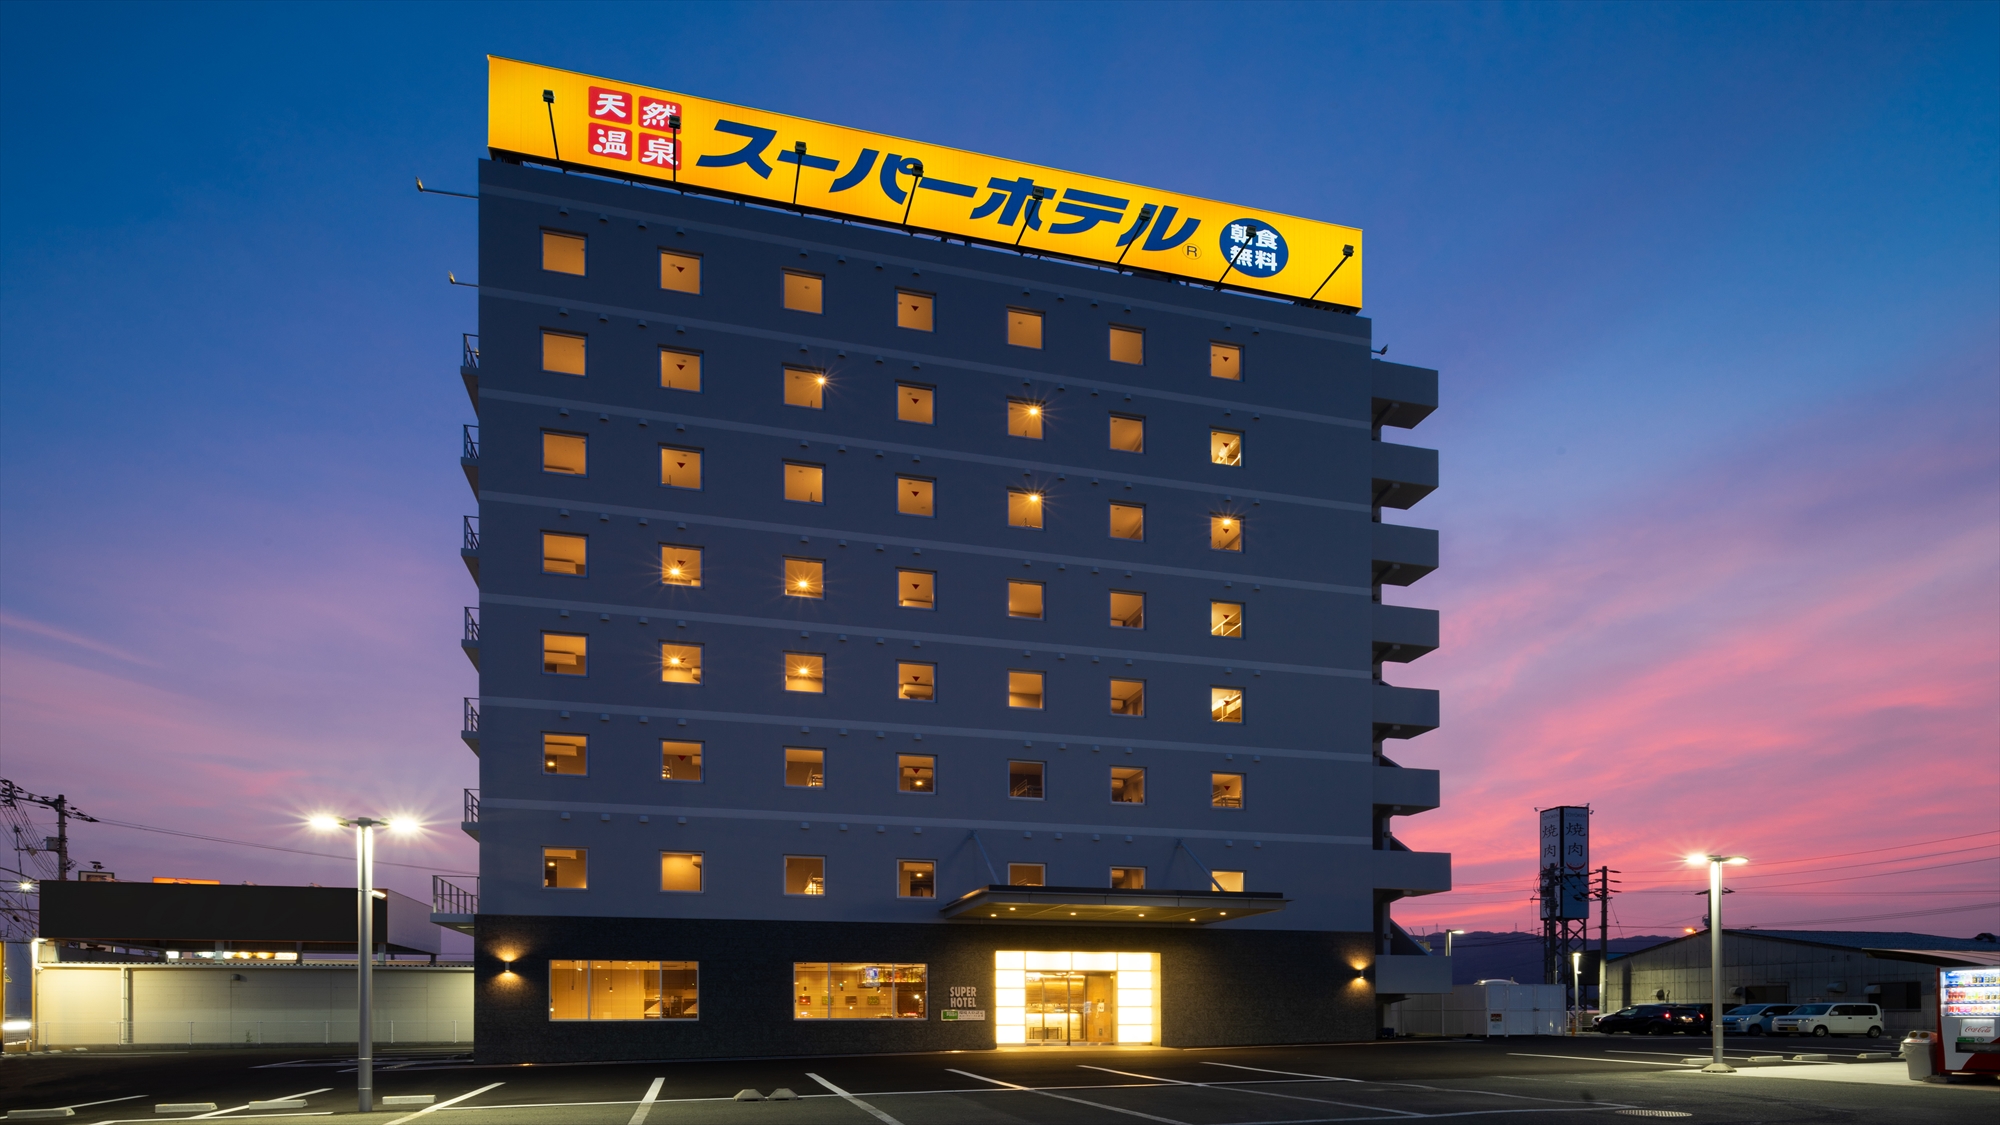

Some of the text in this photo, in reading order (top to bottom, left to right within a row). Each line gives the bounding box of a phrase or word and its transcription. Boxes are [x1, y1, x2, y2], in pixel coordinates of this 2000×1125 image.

[595, 93, 677, 127] 天然
[593, 129, 679, 165] 温泉
[696, 119, 1201, 252] スーパーホテル
[1230, 224, 1278, 250] 朝食
[1230, 245, 1278, 272] 無料
[1542, 824, 1558, 858] 焼肉
[1565, 822, 1586, 857] 焼肉
[950, 986, 977, 997] SUPER
[950, 997, 977, 1008] HOTEL
